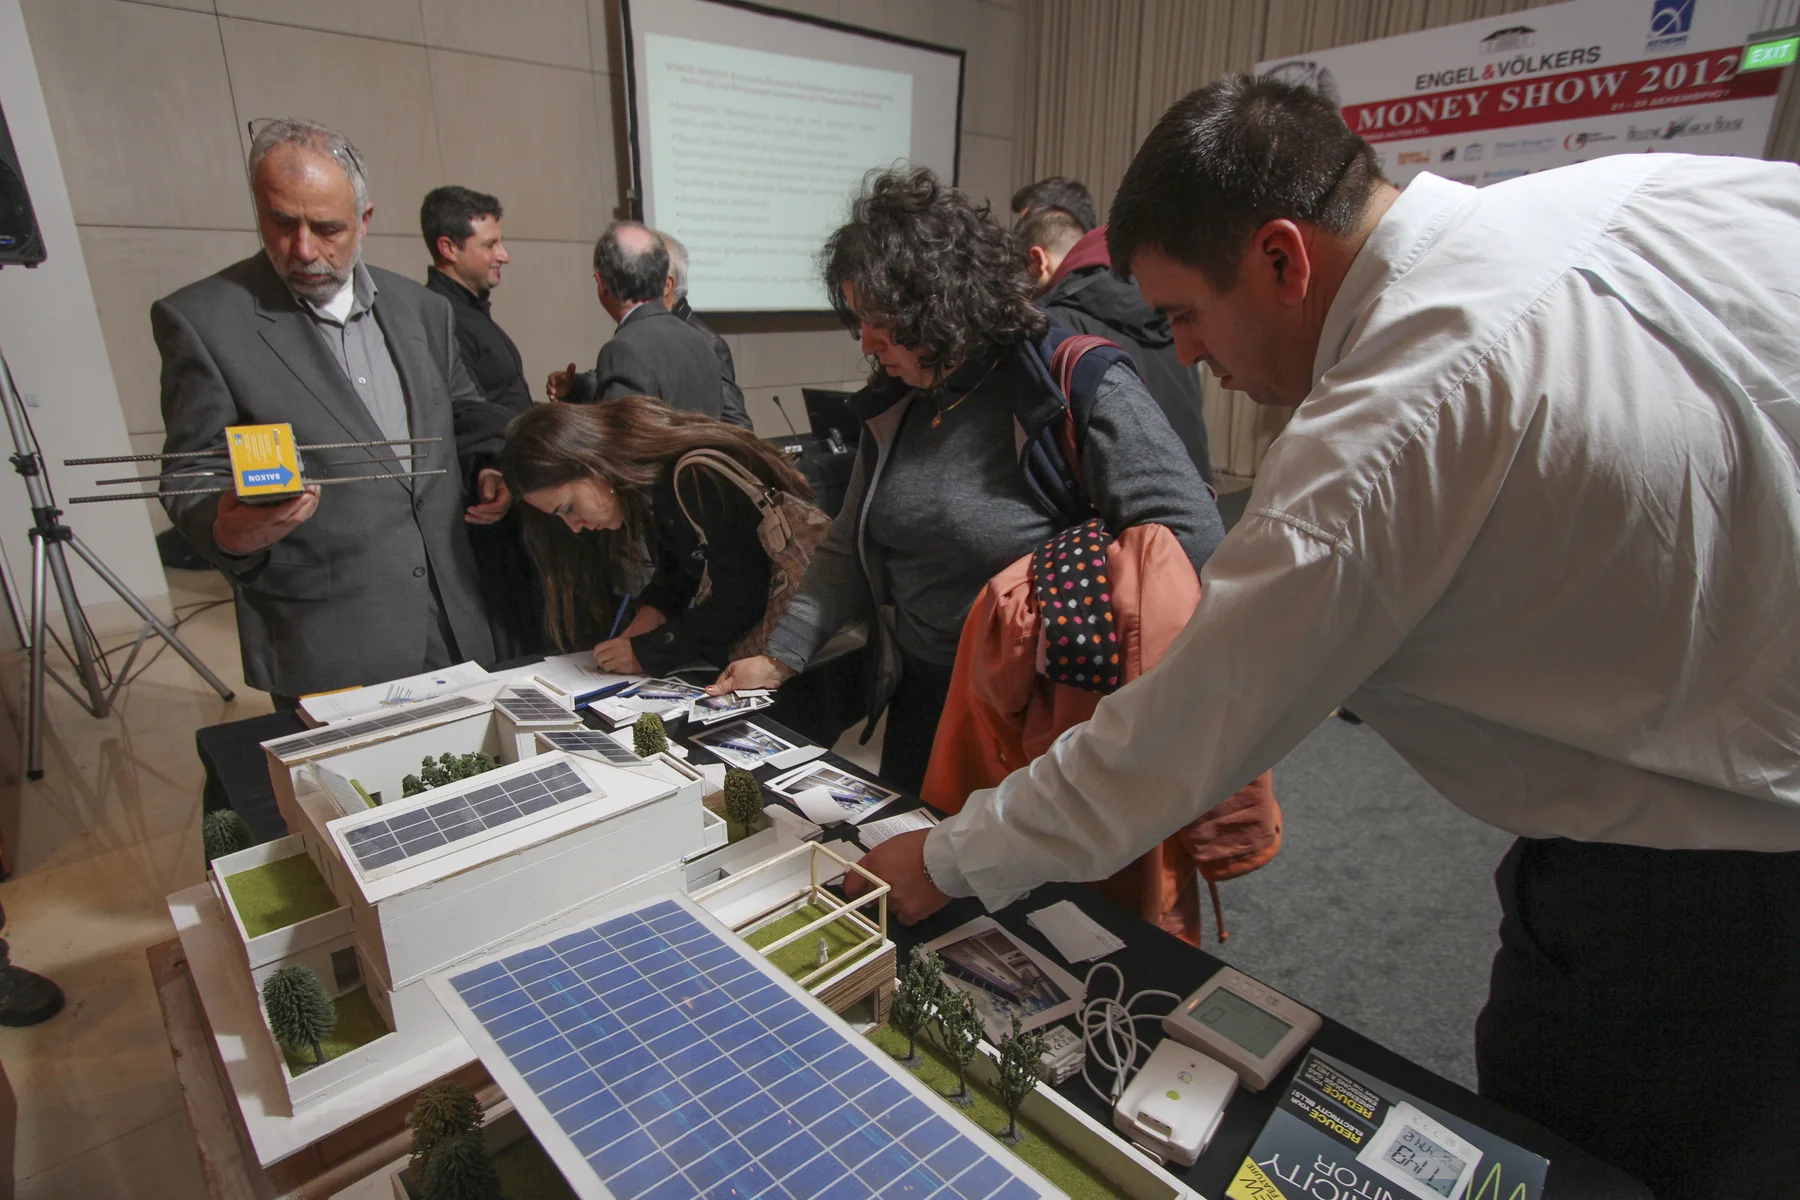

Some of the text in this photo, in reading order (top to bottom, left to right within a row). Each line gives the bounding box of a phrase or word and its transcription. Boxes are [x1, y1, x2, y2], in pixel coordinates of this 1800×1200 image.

[1751, 44, 1792, 63] EXIT
[1357, 54, 1739, 132] MONEY SHOW 2012
[1304, 1072, 1374, 1119] REDUCE YOUR
[1307, 1067, 1376, 1111] GREENHOUSE GAS
[1336, 1078, 1378, 1106] EMISSIONS
[1290, 1097, 1362, 1144] REDUCE YOUR
[1291, 1090, 1364, 1137] ELECTRICITY BILLS!
[1246, 1163, 1280, 1198] FEATURE
